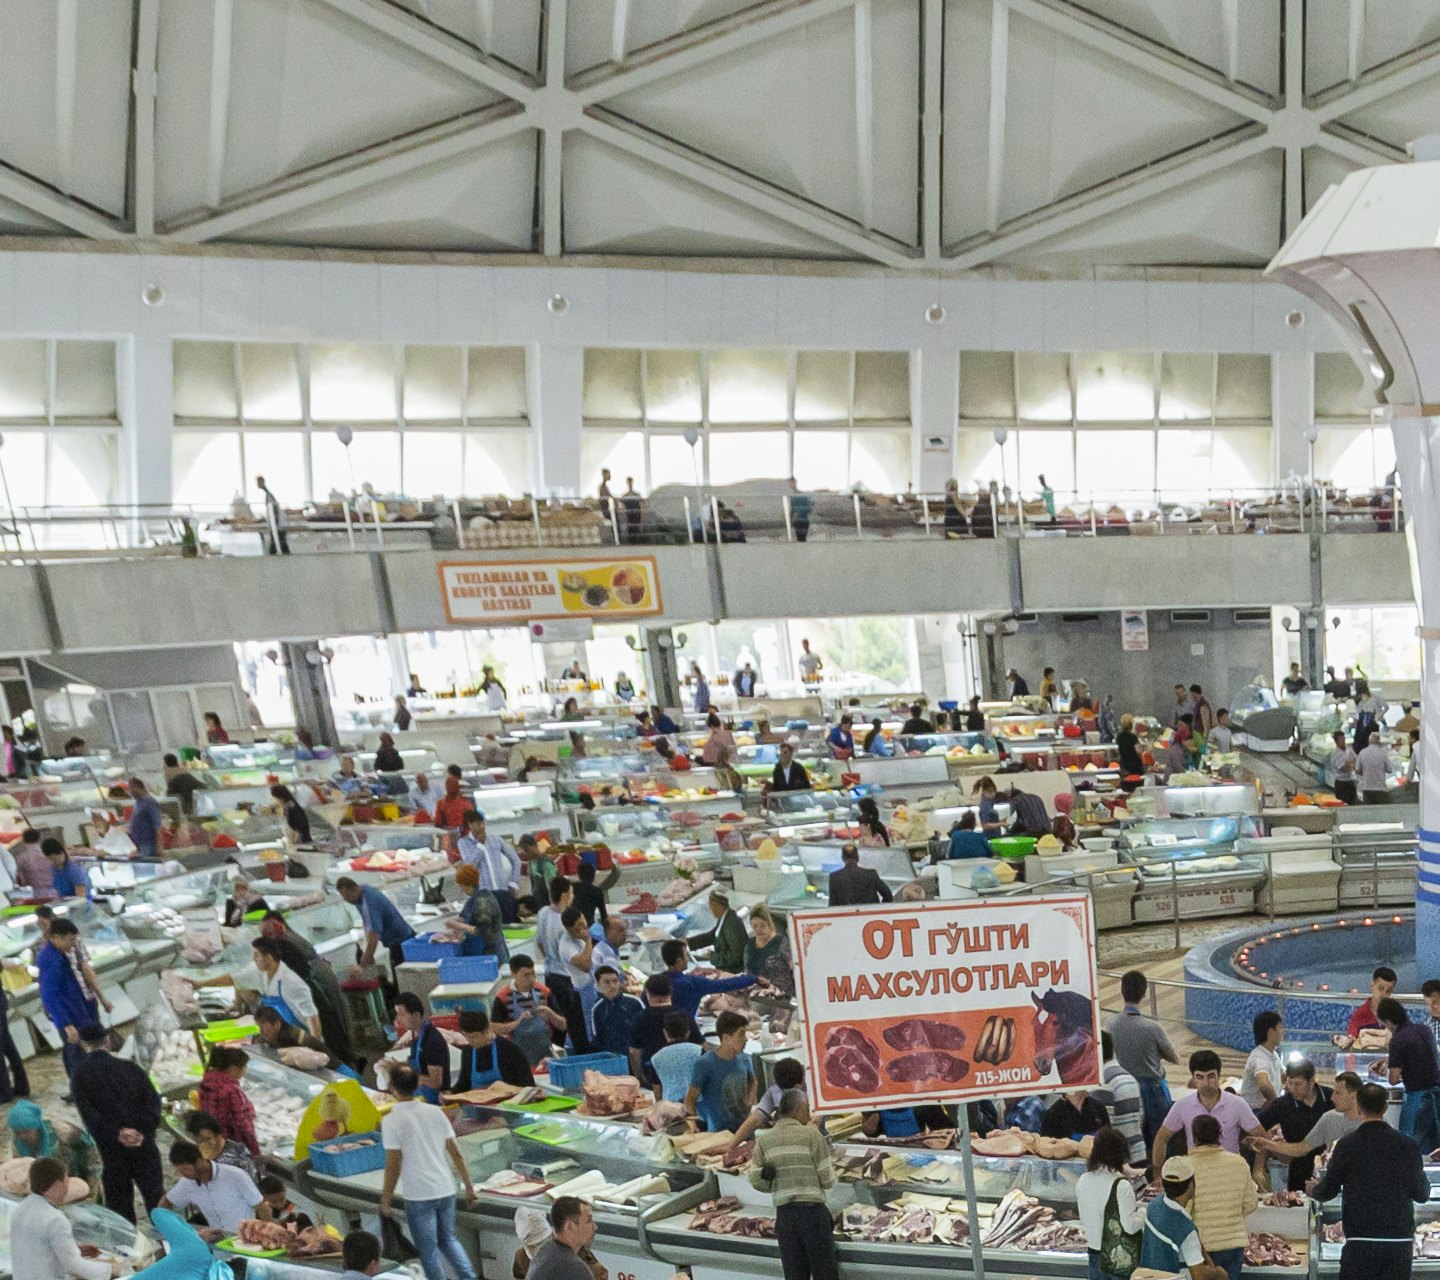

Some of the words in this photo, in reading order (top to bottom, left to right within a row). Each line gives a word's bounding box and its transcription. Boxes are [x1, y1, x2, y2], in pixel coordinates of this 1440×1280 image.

[862, 918, 921, 961] ОТ
[927, 921, 1031, 956] ГЎШТИ
[827, 958, 1071, 1003] МАХСУЛОТЛАРИ
